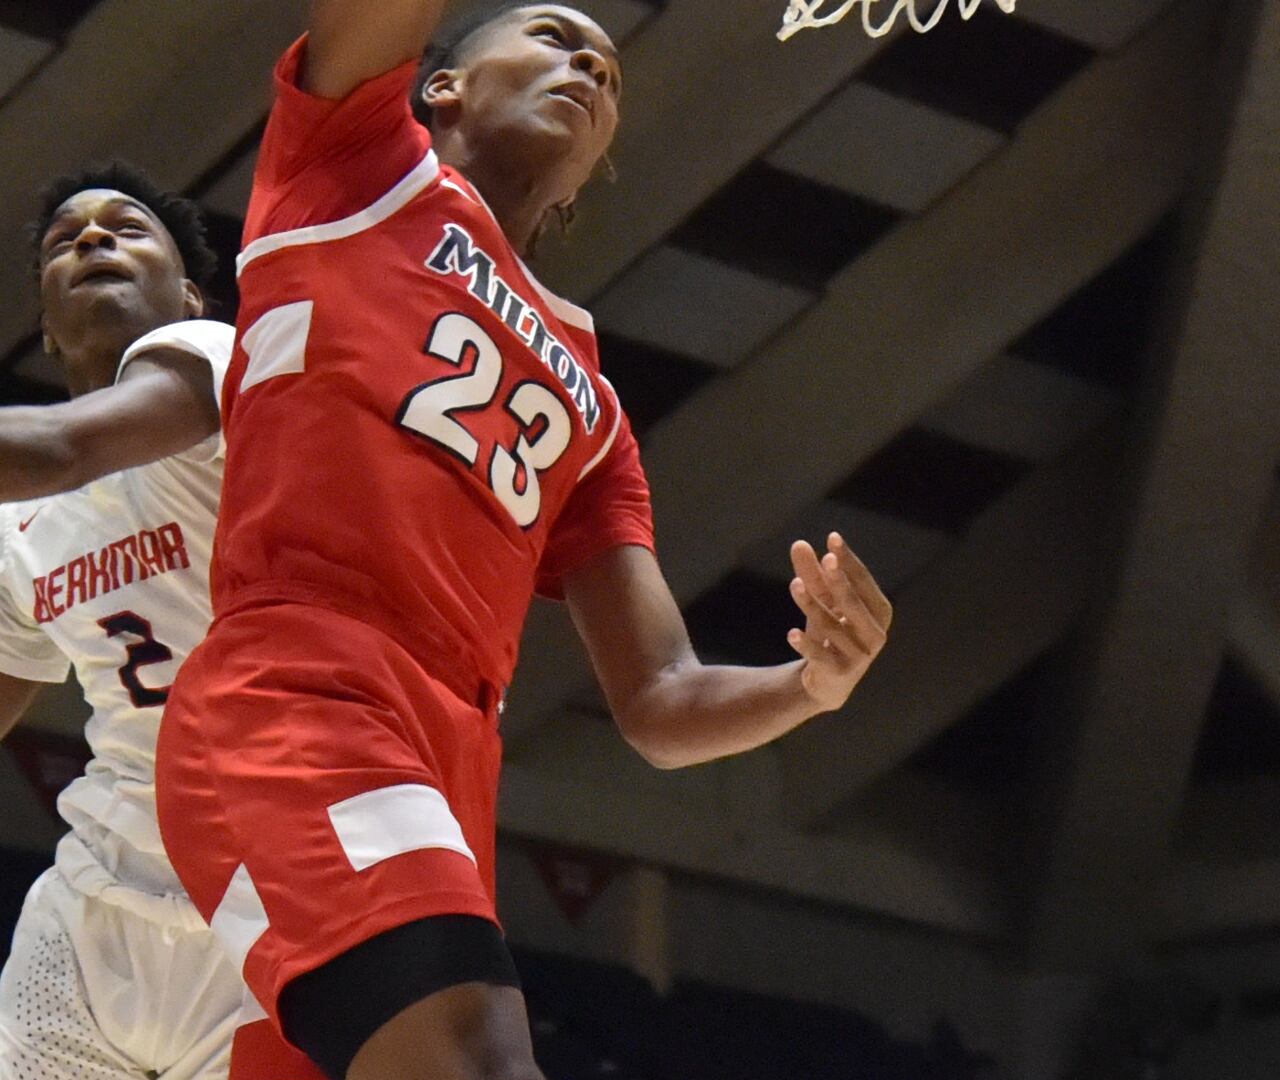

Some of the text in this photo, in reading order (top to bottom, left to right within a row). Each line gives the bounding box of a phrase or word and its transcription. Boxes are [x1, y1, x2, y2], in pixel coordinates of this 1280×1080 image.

[425, 223, 601, 435] MILTON
[396, 310, 572, 532] 23
[33, 521, 190, 624] BERKMAR
[96, 610, 173, 708] 2
